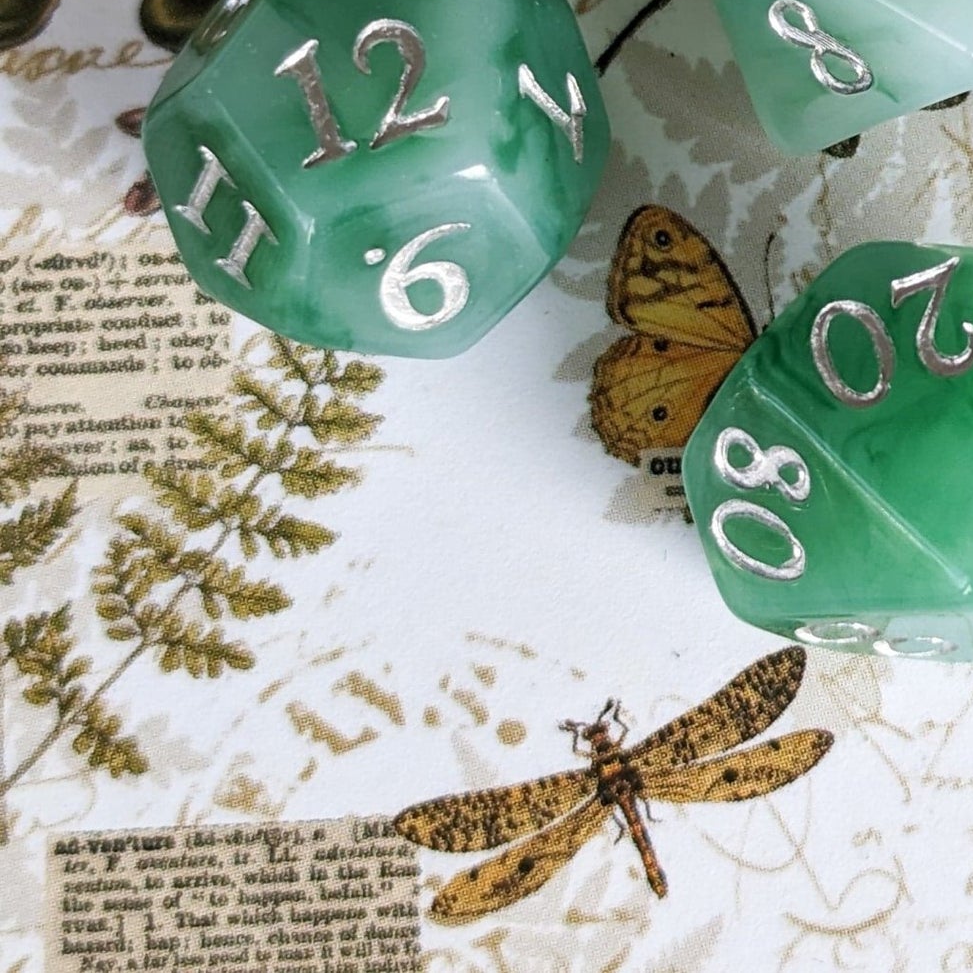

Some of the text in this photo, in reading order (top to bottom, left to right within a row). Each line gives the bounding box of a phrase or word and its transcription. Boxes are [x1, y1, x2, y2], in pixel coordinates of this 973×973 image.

[274, 18, 451, 169] 12
[173, 144, 280, 291] 11
[711, 427, 811, 581] 80
